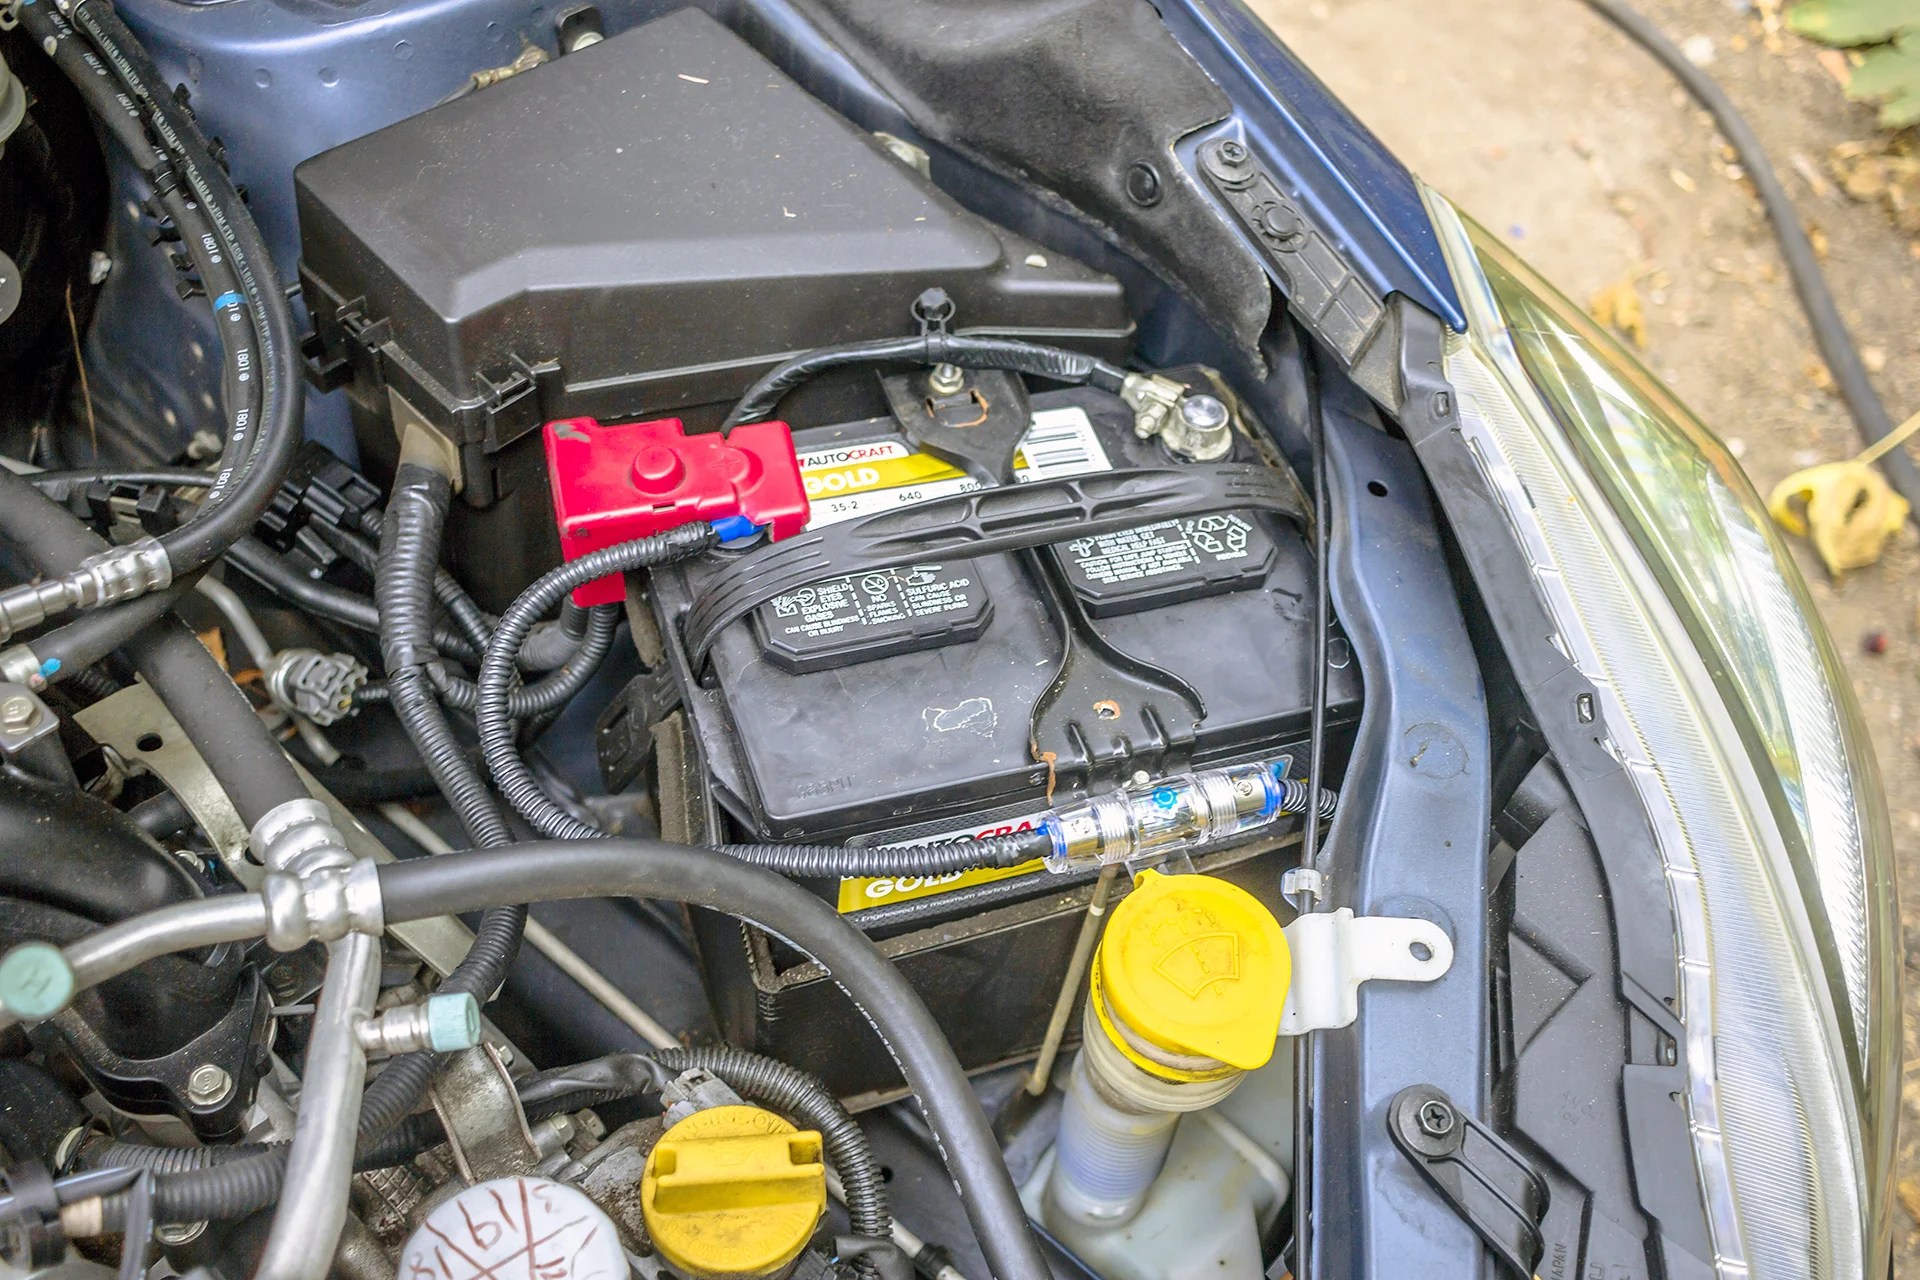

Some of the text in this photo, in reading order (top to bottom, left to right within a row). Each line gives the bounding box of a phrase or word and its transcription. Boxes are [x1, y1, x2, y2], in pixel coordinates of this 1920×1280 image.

[201, 232, 220, 254] 1801
[223, 289, 240, 312] 101
[237, 348, 250, 372] 1801
[234, 408, 250, 432] 1801
[807, 445, 893, 467] AUTOCRAFT
[214, 467, 234, 489] 1801
[804, 467, 880, 495] GOLD
[831, 500, 860, 514] 35-2
[898, 490, 923, 502] 640
[1140, 531, 1156, 540] GET
[1100, 536, 1166, 555] MEDICAL HELP FAST
[1215, 549, 1248, 561] RECYCLE
[817, 583, 849, 596] SHIELD
[905, 578, 970, 596] SULFURIC ACID
[819, 592, 844, 604] EYES
[871, 593, 887, 603] NO
[909, 590, 951, 603] CAN CAUSE
[911, 593, 967, 610] BLINDNESS OR
[801, 599, 850, 615] EXPLOSIVE
[914, 600, 969, 617] SEVERE BURNS
[785, 615, 861, 634] CAN CAUSE BLINDNESS
[804, 610, 835, 623] GASES
[807, 625, 844, 637] OR INJURY
[861, 878, 1041, 922] Engineered for maximum starting power
[666, 1111, 750, 1141] ENGINE
